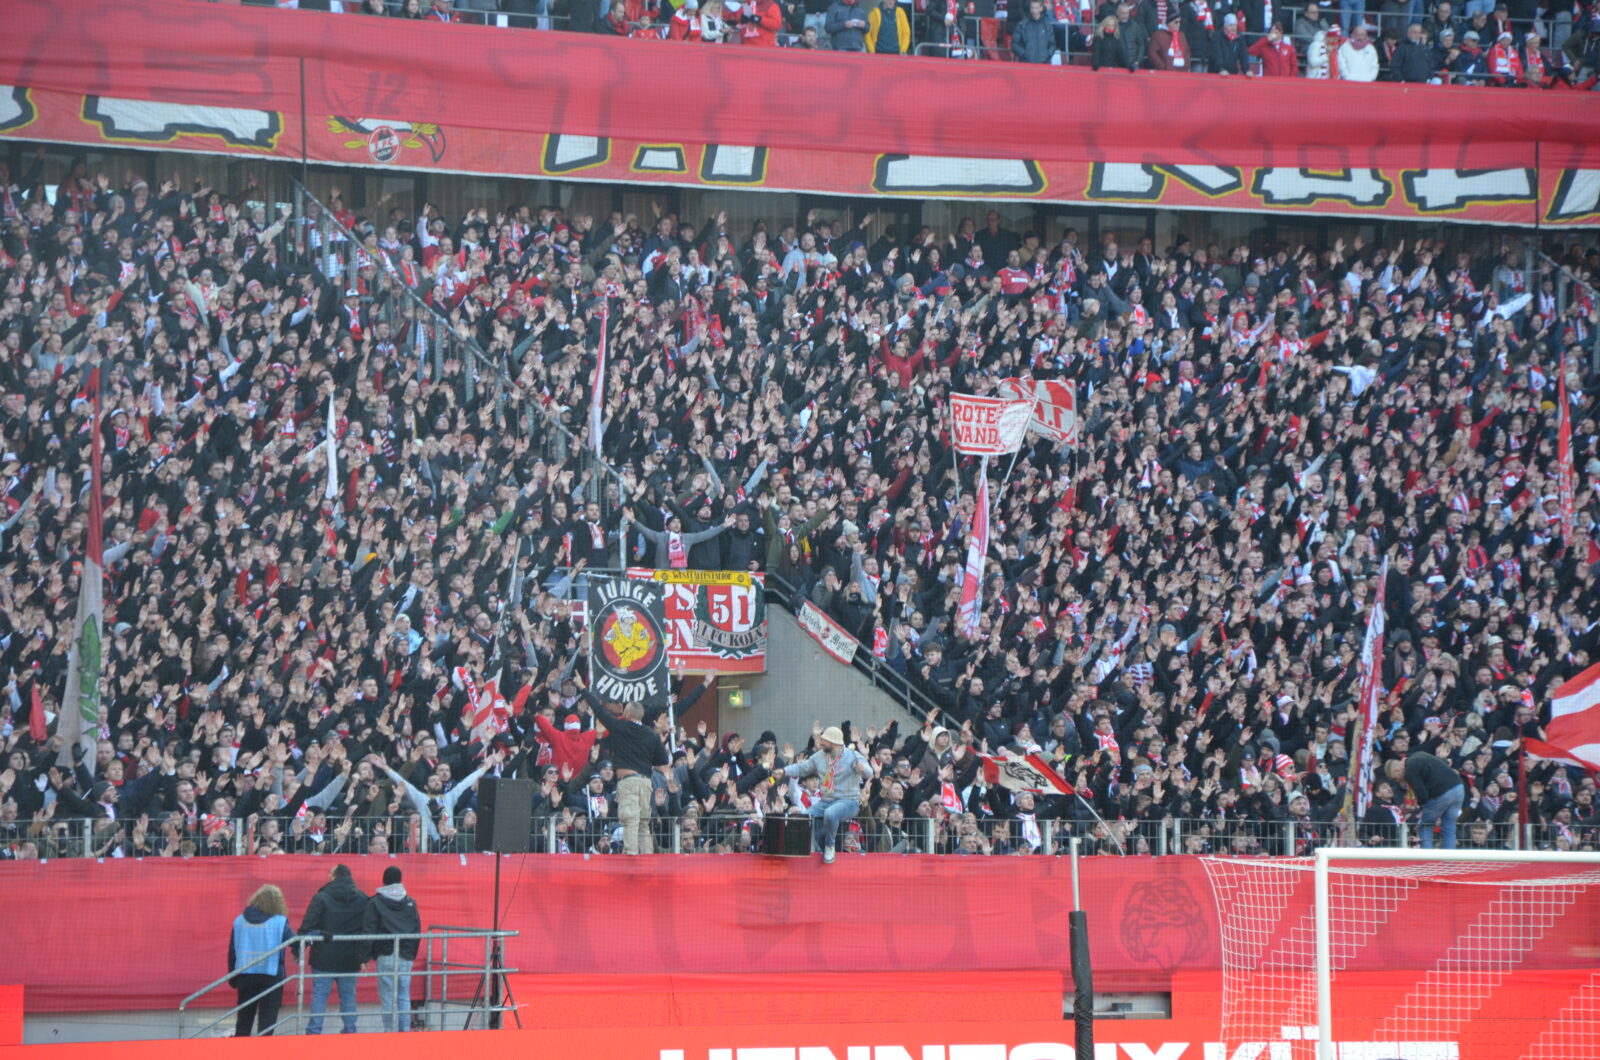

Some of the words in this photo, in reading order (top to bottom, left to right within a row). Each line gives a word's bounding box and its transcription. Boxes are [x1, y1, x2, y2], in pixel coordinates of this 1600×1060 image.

[952, 402, 998, 424] ROTE
[953, 424, 999, 445] WAND
[597, 580, 656, 608] JUNGE
[712, 593, 750, 624] 51
[596, 674, 659, 703] HORDE
